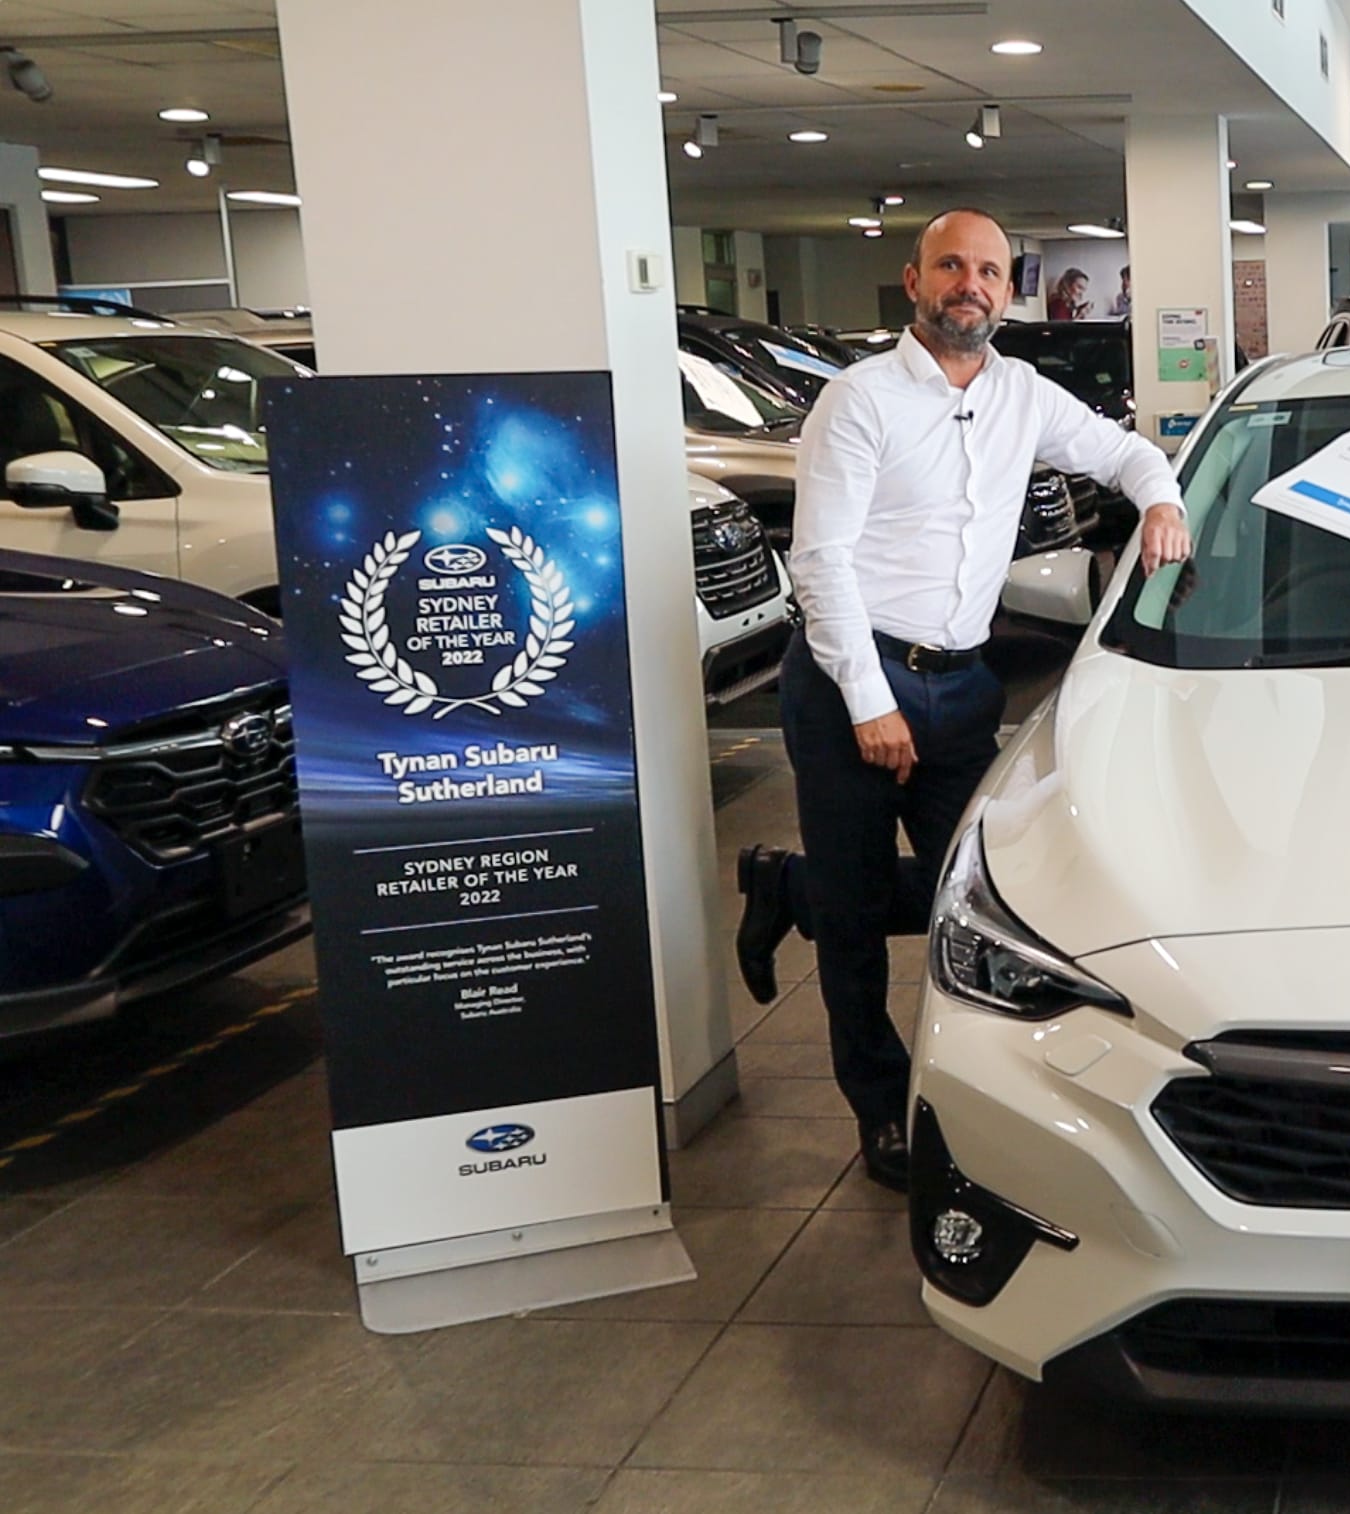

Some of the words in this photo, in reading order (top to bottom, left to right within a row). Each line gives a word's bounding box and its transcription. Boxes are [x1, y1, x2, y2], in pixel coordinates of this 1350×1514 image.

[418, 575, 496, 591] SUBARU
[418, 594, 499, 614] SYDNEY
[416, 613, 503, 633] RETAILER
[406, 636, 432, 651] OF
[435, 634, 469, 649] THE
[470, 631, 516, 647] YEAR
[441, 650, 484, 666] 2022
[377, 751, 458, 779] Tynan
[464, 742, 559, 768] Subaru
[398, 770, 543, 803] Sutherland
[404, 856, 476, 877] SYDNEY
[480, 849, 549, 868] REGION
[376, 875, 459, 897] RETAILER
[463, 872, 489, 888] OF
[496, 869, 529, 885] THE
[533, 864, 579, 881] YEAR
[460, 889, 501, 906] 2022
[385, 961, 441, 975] outstanding
[442, 958, 475, 968] service
[477, 954, 506, 964] across
[507, 951, 522, 960] the
[566, 945, 586, 953] with
[396, 951, 424, 962] award
[387, 973, 432, 988] particular
[433, 971, 458, 981] focus
[460, 969, 473, 978] on
[474, 966, 490, 976] the
[491, 963, 533, 974] customer
[460, 986, 486, 999] Blair
[489, 983, 518, 996] Read
[458, 1152, 547, 1177] SUBARU
